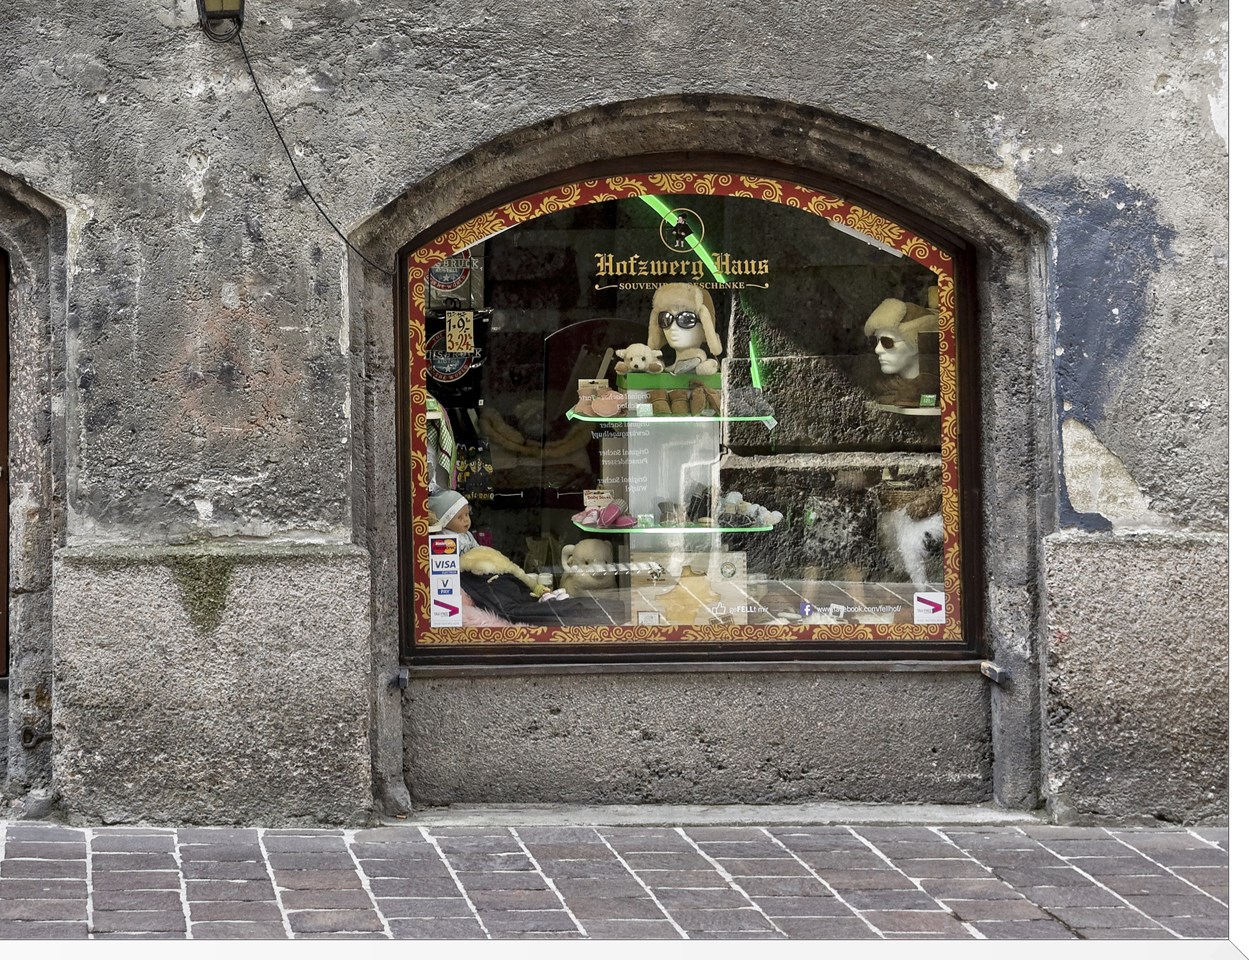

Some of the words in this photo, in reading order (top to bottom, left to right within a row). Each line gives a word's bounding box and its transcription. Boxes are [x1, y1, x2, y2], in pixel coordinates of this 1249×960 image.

[594, 253, 704, 280] Hofzwerg
[712, 253, 769, 276] Haus
[434, 560, 456, 569] VISA
[441, 579, 449, 588] V
